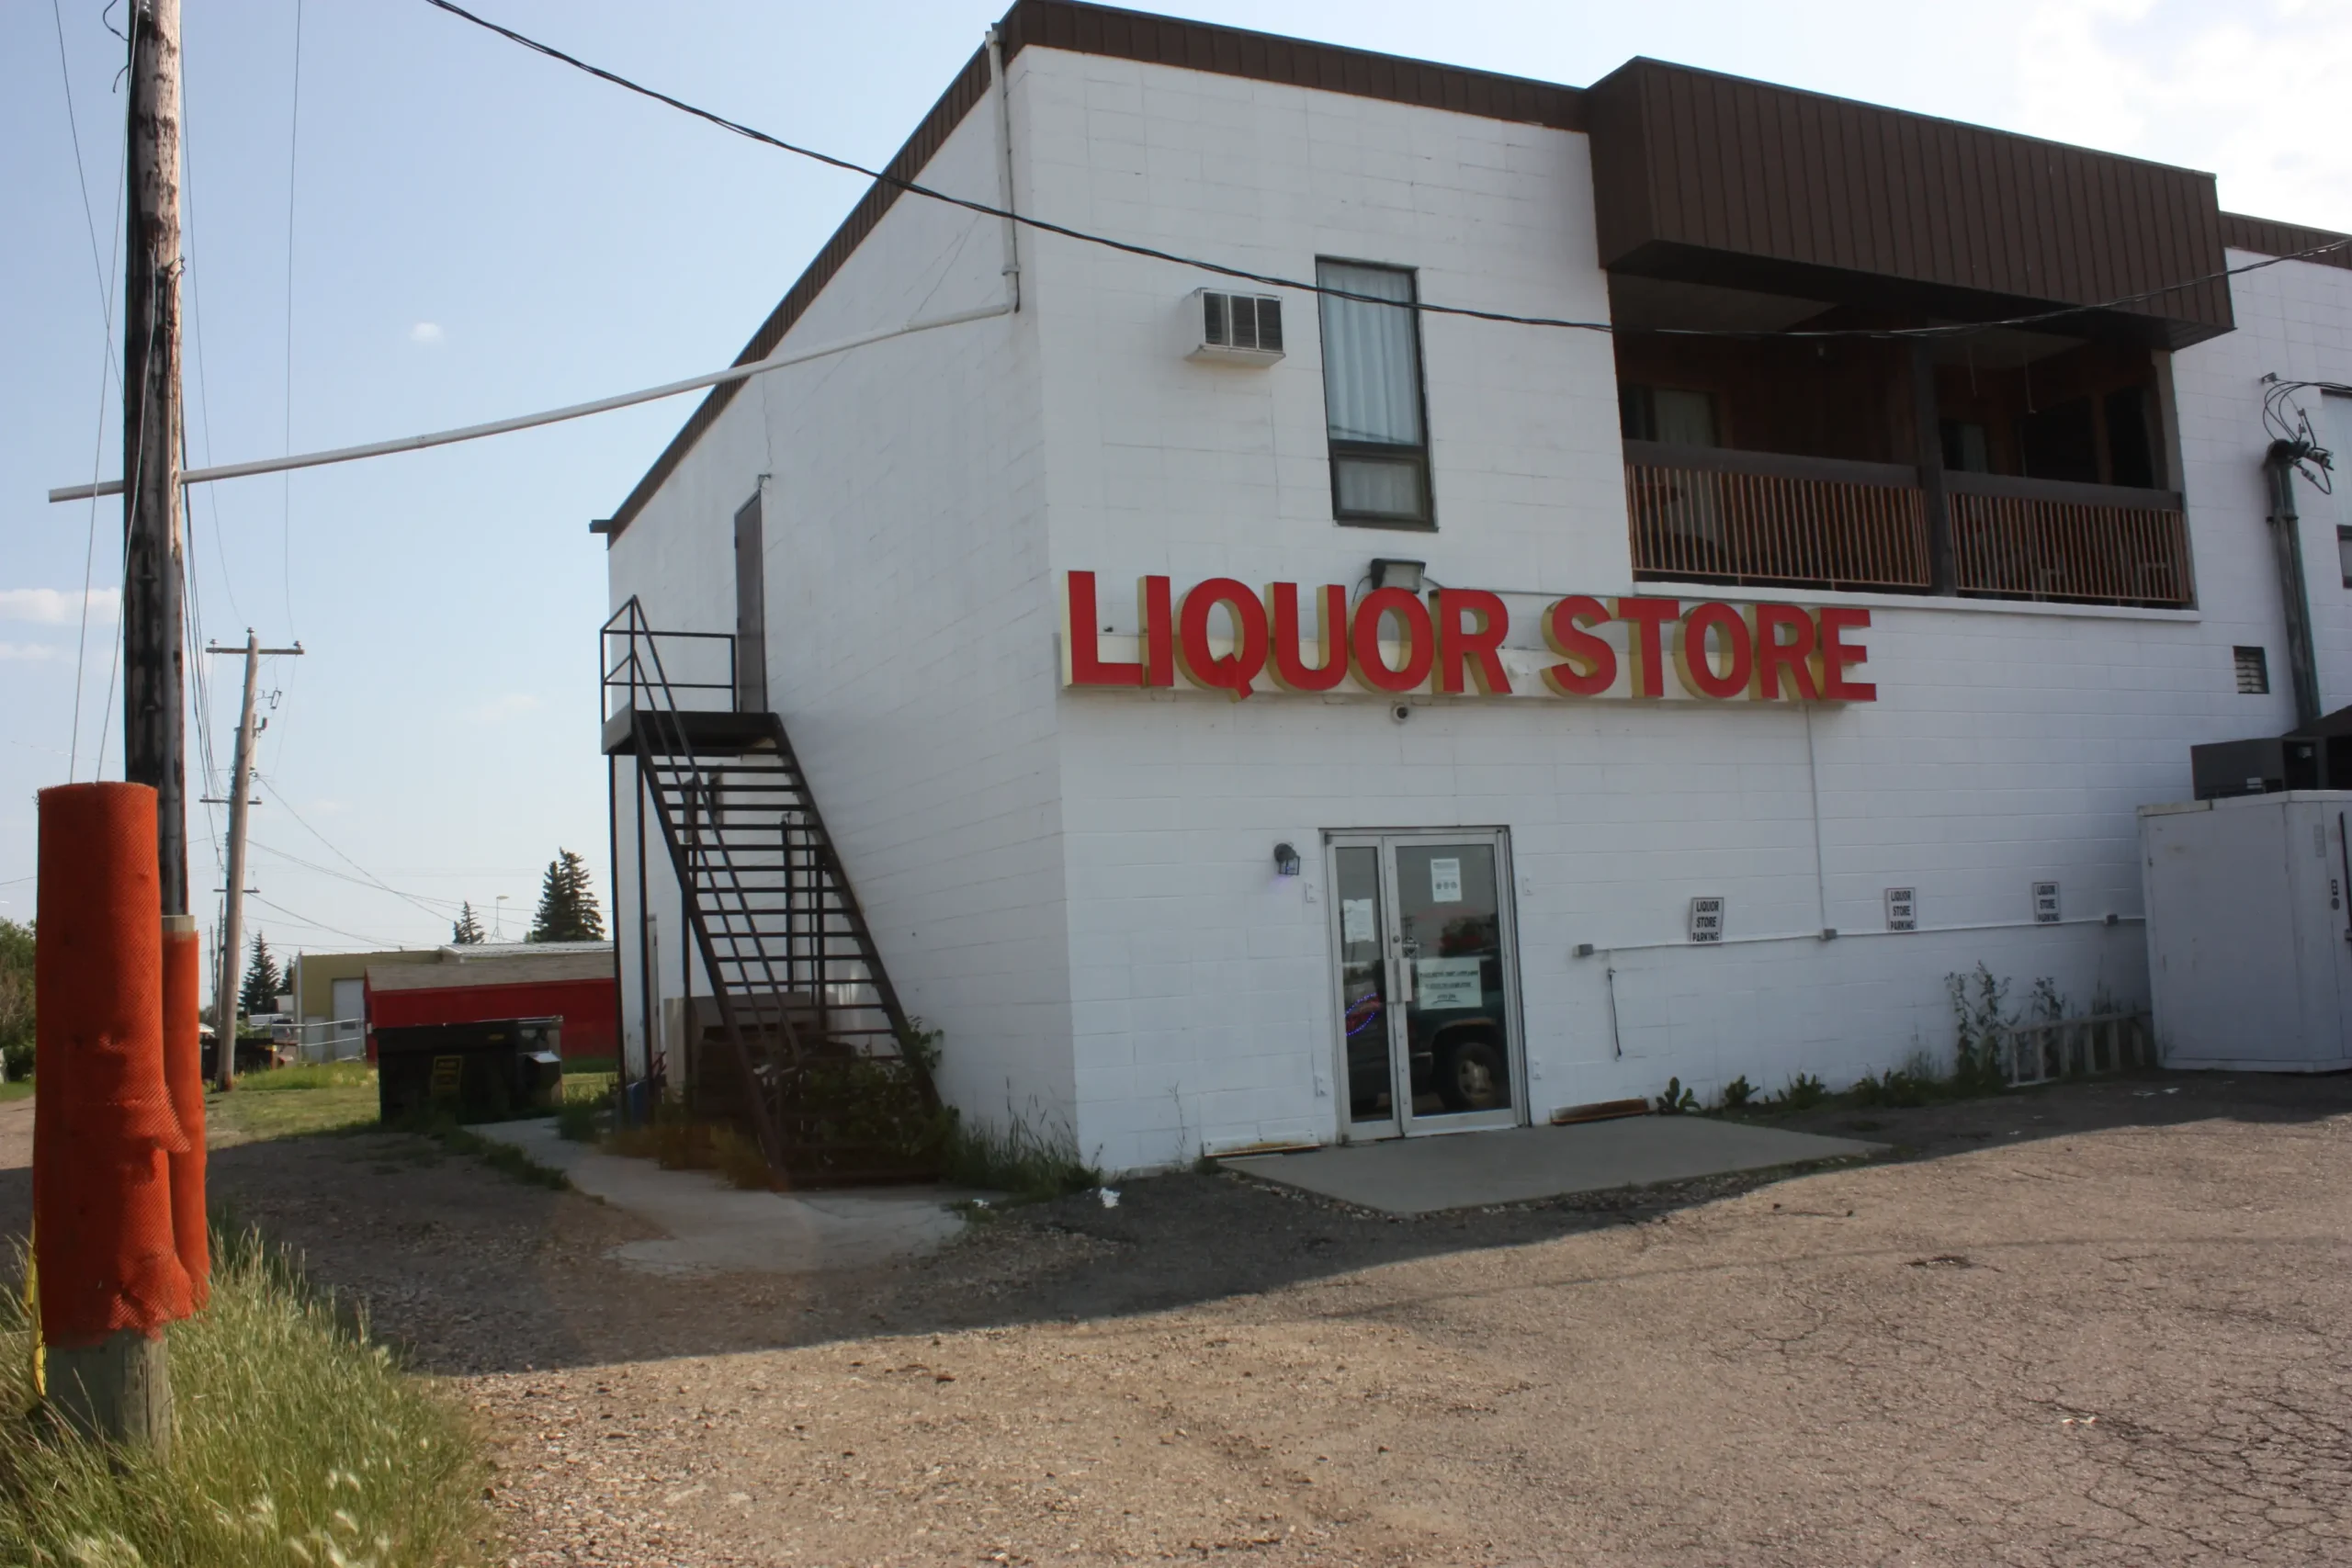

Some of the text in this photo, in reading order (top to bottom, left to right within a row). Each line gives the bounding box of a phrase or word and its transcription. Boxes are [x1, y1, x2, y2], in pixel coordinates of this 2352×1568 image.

[1064, 570, 1877, 703] LIQUOR STORE
[1891, 890, 1911, 901] LIQUOR
[2037, 885, 2055, 896] LIQUOR
[1696, 901, 1719, 912] LIQUOR
[2040, 898, 2055, 909] STORE
[1893, 905, 1911, 916] STORE
[1697, 916, 1717, 928] STORE
[1890, 919, 1914, 931] PARKING
[1692, 931, 1719, 942] PARKING
